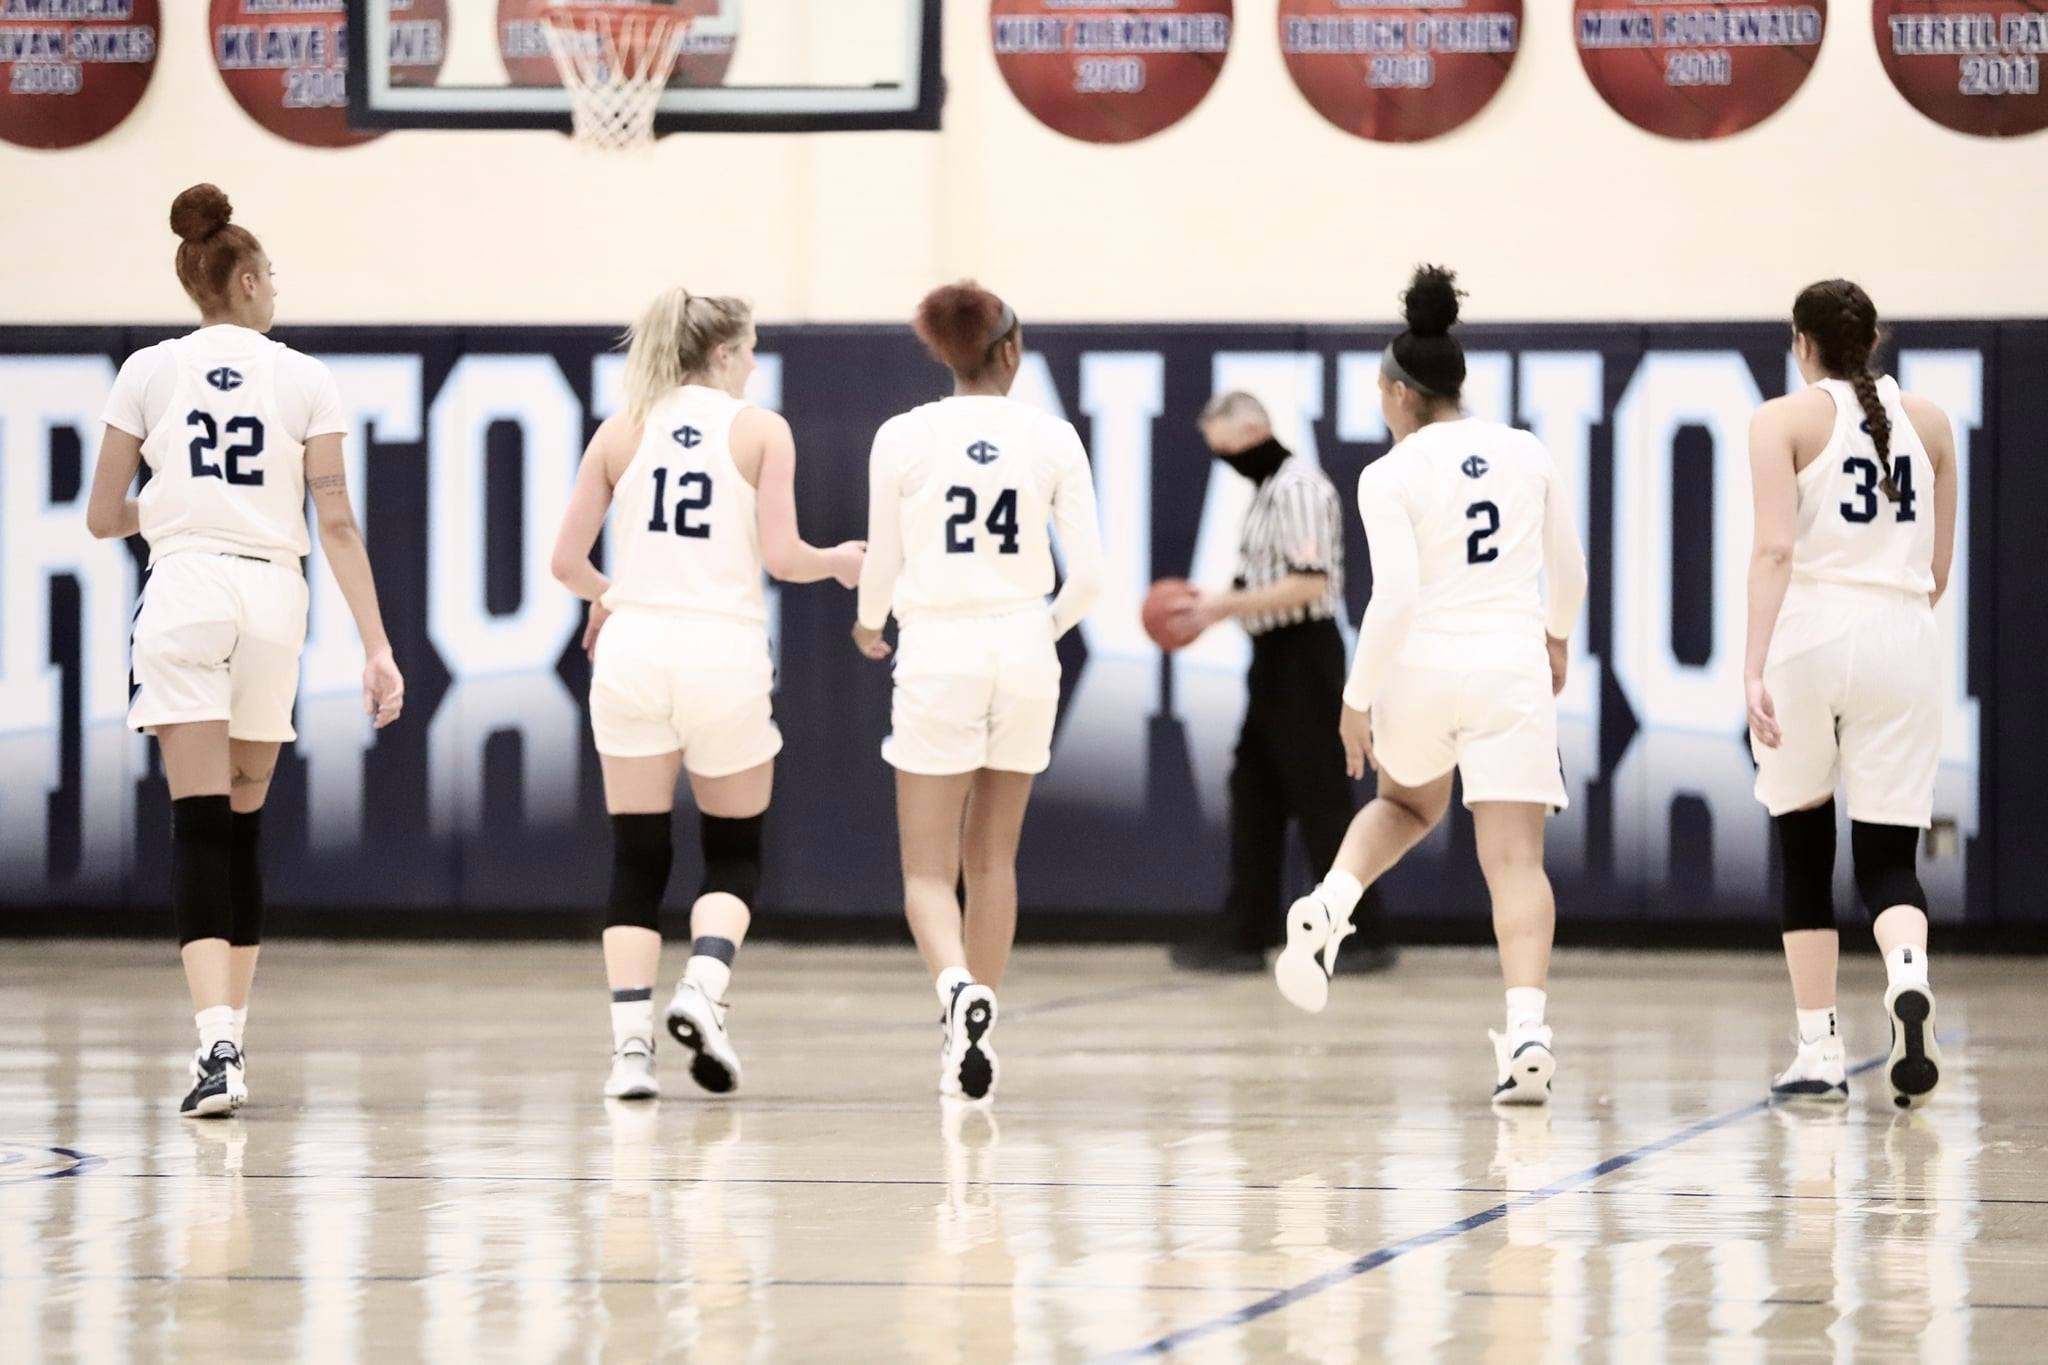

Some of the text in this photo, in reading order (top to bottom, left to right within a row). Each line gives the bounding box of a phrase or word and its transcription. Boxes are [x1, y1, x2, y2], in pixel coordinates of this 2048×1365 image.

[2000, 12, 2048, 54] PA
[282, 69, 349, 107] 200
[1664, 48, 1732, 86] 2011
[1959, 54, 2040, 95] 2011
[187, 409, 264, 486] 22
[648, 467, 712, 539] 12
[945, 485, 1019, 554] 24
[1840, 455, 1916, 523] 34
[0, 351, 782, 734] RTO
[1466, 500, 1500, 564] 2
